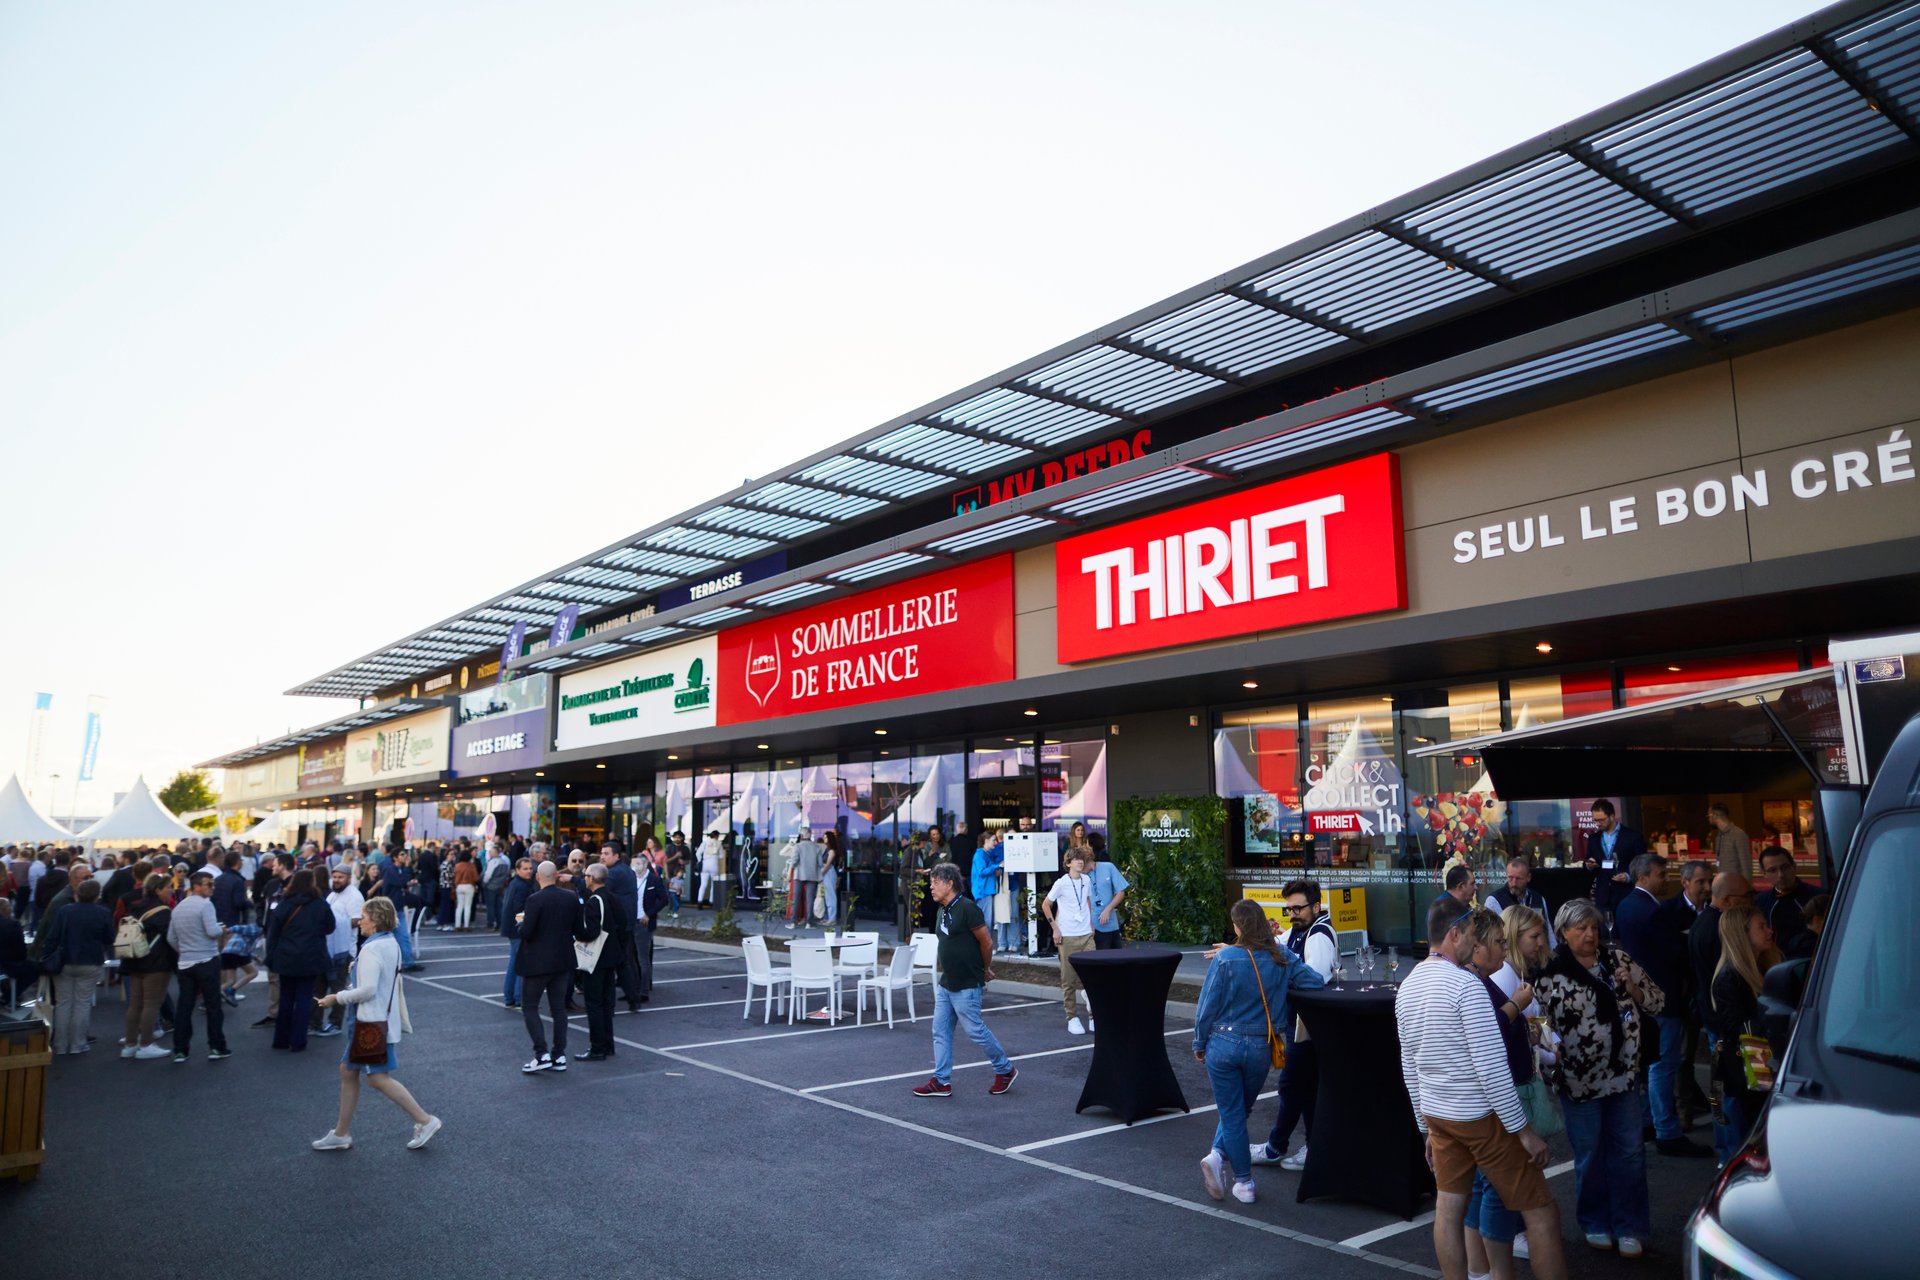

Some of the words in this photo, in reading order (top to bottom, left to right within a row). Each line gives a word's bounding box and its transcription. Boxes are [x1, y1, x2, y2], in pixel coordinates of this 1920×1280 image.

[1453, 514, 1565, 563] SEUL
[1580, 497, 1638, 540] LE
[1656, 469, 1769, 526] BON
[1790, 430, 1916, 498] CRÉ
[1081, 494, 1345, 630] THIRIET
[690, 571, 742, 600] TERRASSE
[791, 588, 958, 658] SOMMELLERIE
[791, 666, 819, 699] DE
[826, 645, 919, 693] FRANCE
[466, 738, 494, 758] ACCES
[494, 732, 524, 753] ETAGE
[1305, 762, 1368, 786] CLICK
[1368, 760, 1385, 783] &
[1307, 784, 1399, 808] COLLECT
[1142, 828, 1164, 838] FOOD
[1164, 828, 1191, 838] PLACE
[1313, 815, 1355, 829] THIRIET
[1376, 808, 1402, 832] 1h
